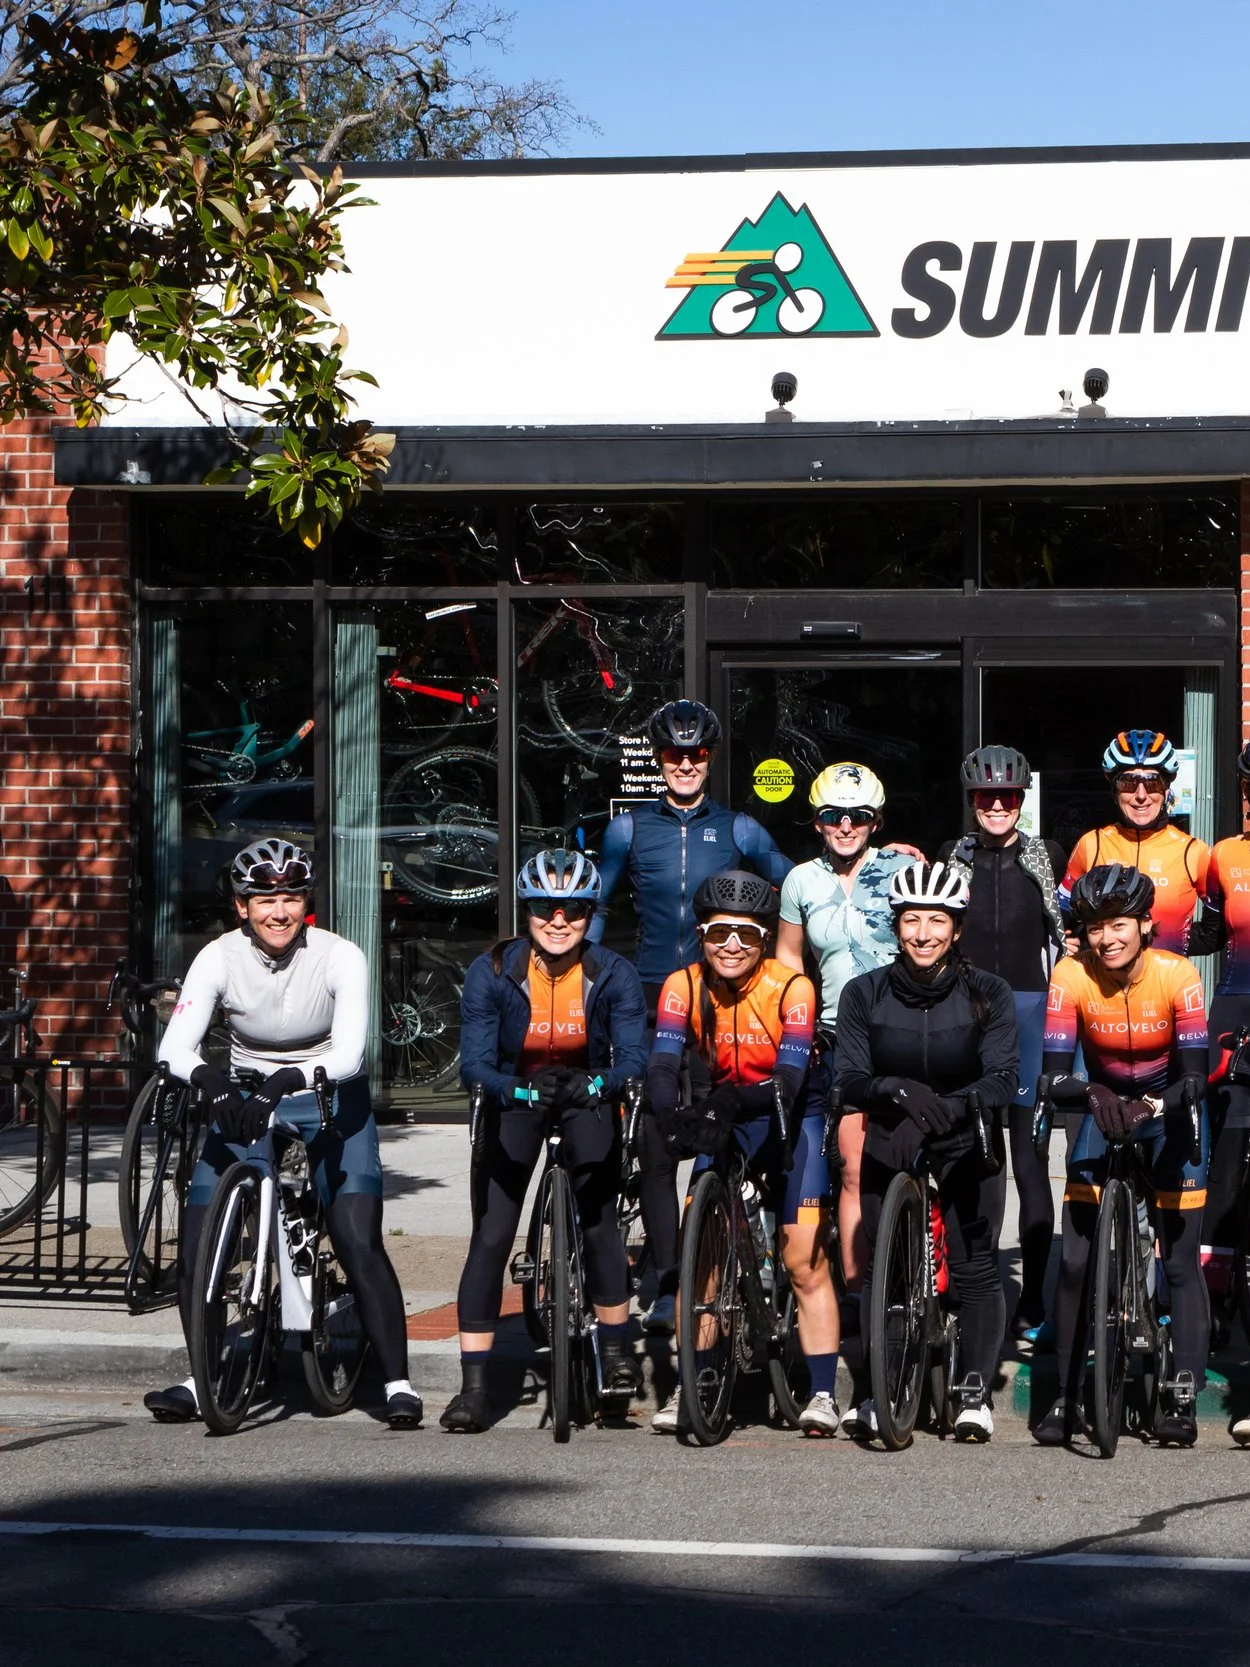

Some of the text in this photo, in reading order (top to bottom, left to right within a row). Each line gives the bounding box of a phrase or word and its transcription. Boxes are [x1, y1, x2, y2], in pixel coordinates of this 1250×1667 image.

[618, 735, 642, 745] Store
[623, 747, 653, 757] Weekd
[755, 776, 793, 785] CAUTION
[620, 784, 644, 793] 10am
[529, 1020, 585, 1035] TO VEL
[1089, 1020, 1168, 1033] ALTO VELO
